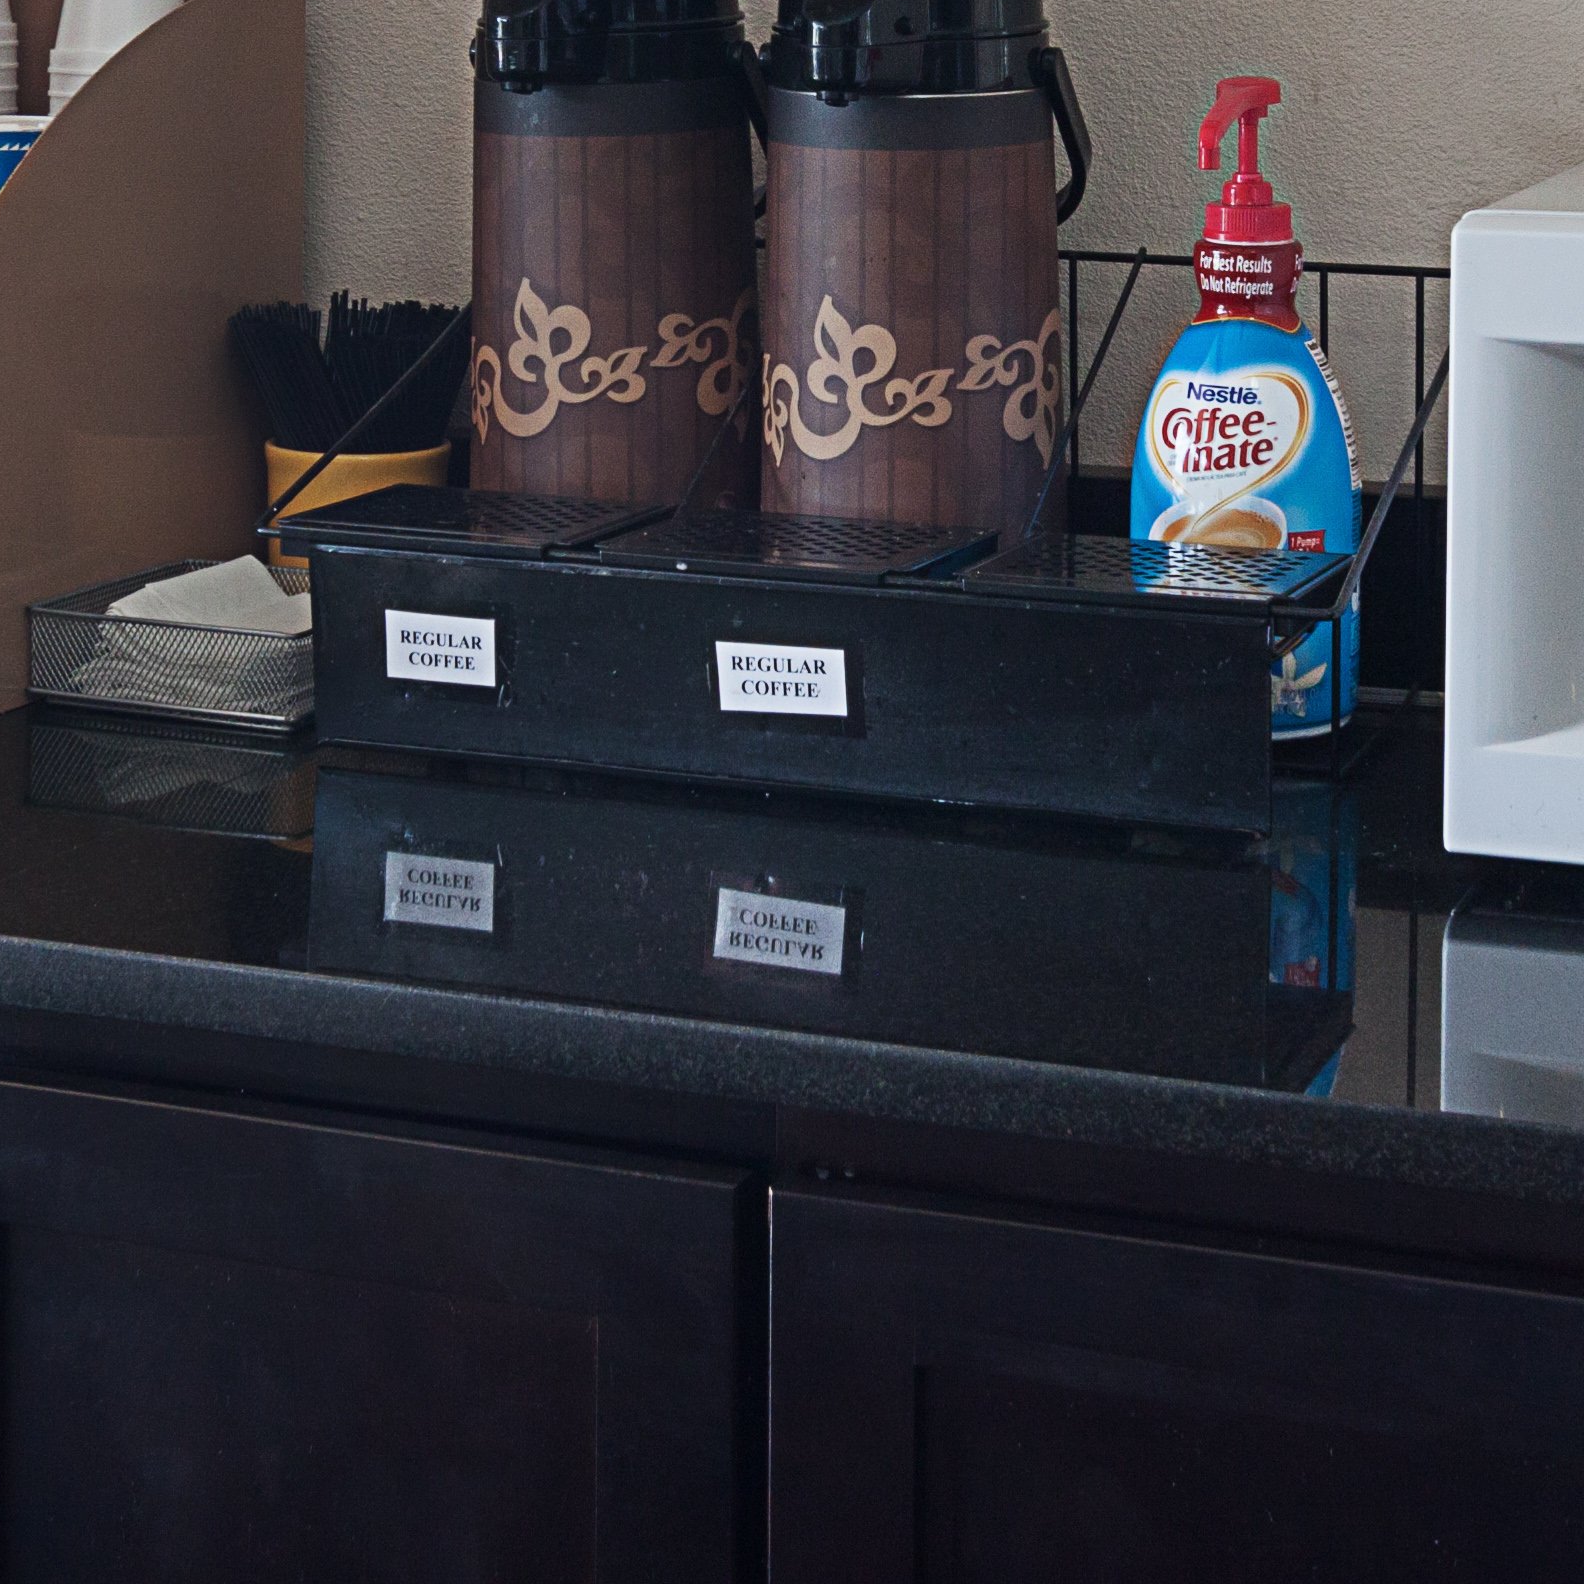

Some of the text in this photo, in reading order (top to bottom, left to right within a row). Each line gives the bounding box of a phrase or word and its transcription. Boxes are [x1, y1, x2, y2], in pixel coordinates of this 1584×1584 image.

[1200, 251, 1213, 269] For
[1236, 255, 1273, 274] Results
[1200, 273, 1209, 290] Do
[1210, 275, 1224, 292] Not
[1225, 276, 1274, 299] Refrigerate
[1182, 438, 1274, 473] mate
[400, 629, 482, 650] REGULAR
[409, 651, 476, 671] COFFEE
[731, 656, 827, 675] REGULAR
[741, 679, 819, 698] COFFEE
